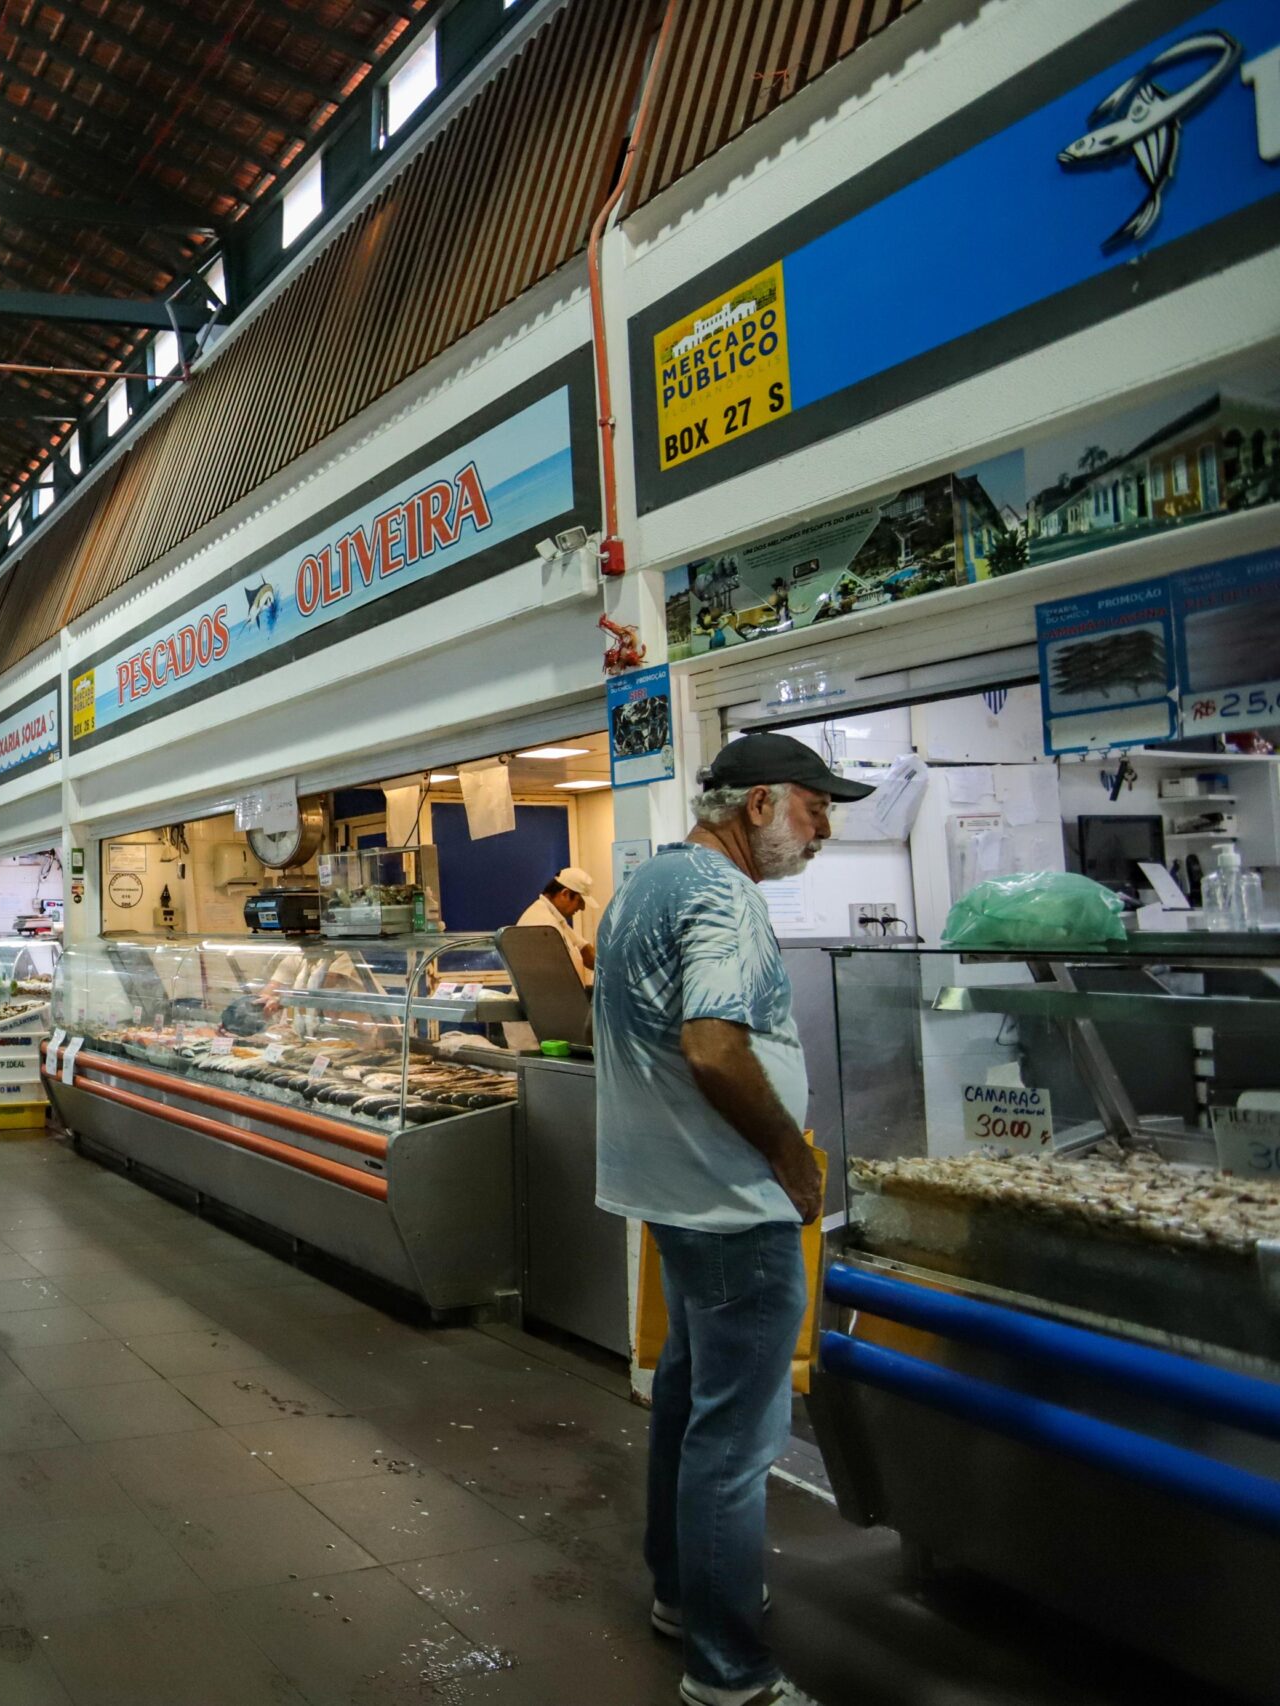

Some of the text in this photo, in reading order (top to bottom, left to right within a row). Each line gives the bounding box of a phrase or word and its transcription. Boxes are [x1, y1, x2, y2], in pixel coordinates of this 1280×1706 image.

[662, 309, 776, 385] MERCADO
[664, 381, 785, 462] BOX 27 S
[294, 460, 493, 618] OLIVEIRA
[767, 530, 801, 548] MELHORES
[833, 516, 844, 526] DO
[1097, 588, 1162, 609] PROMOÇÃO
[115, 604, 231, 708] PESCADOS
[21, 714, 48, 746] SOUZA
